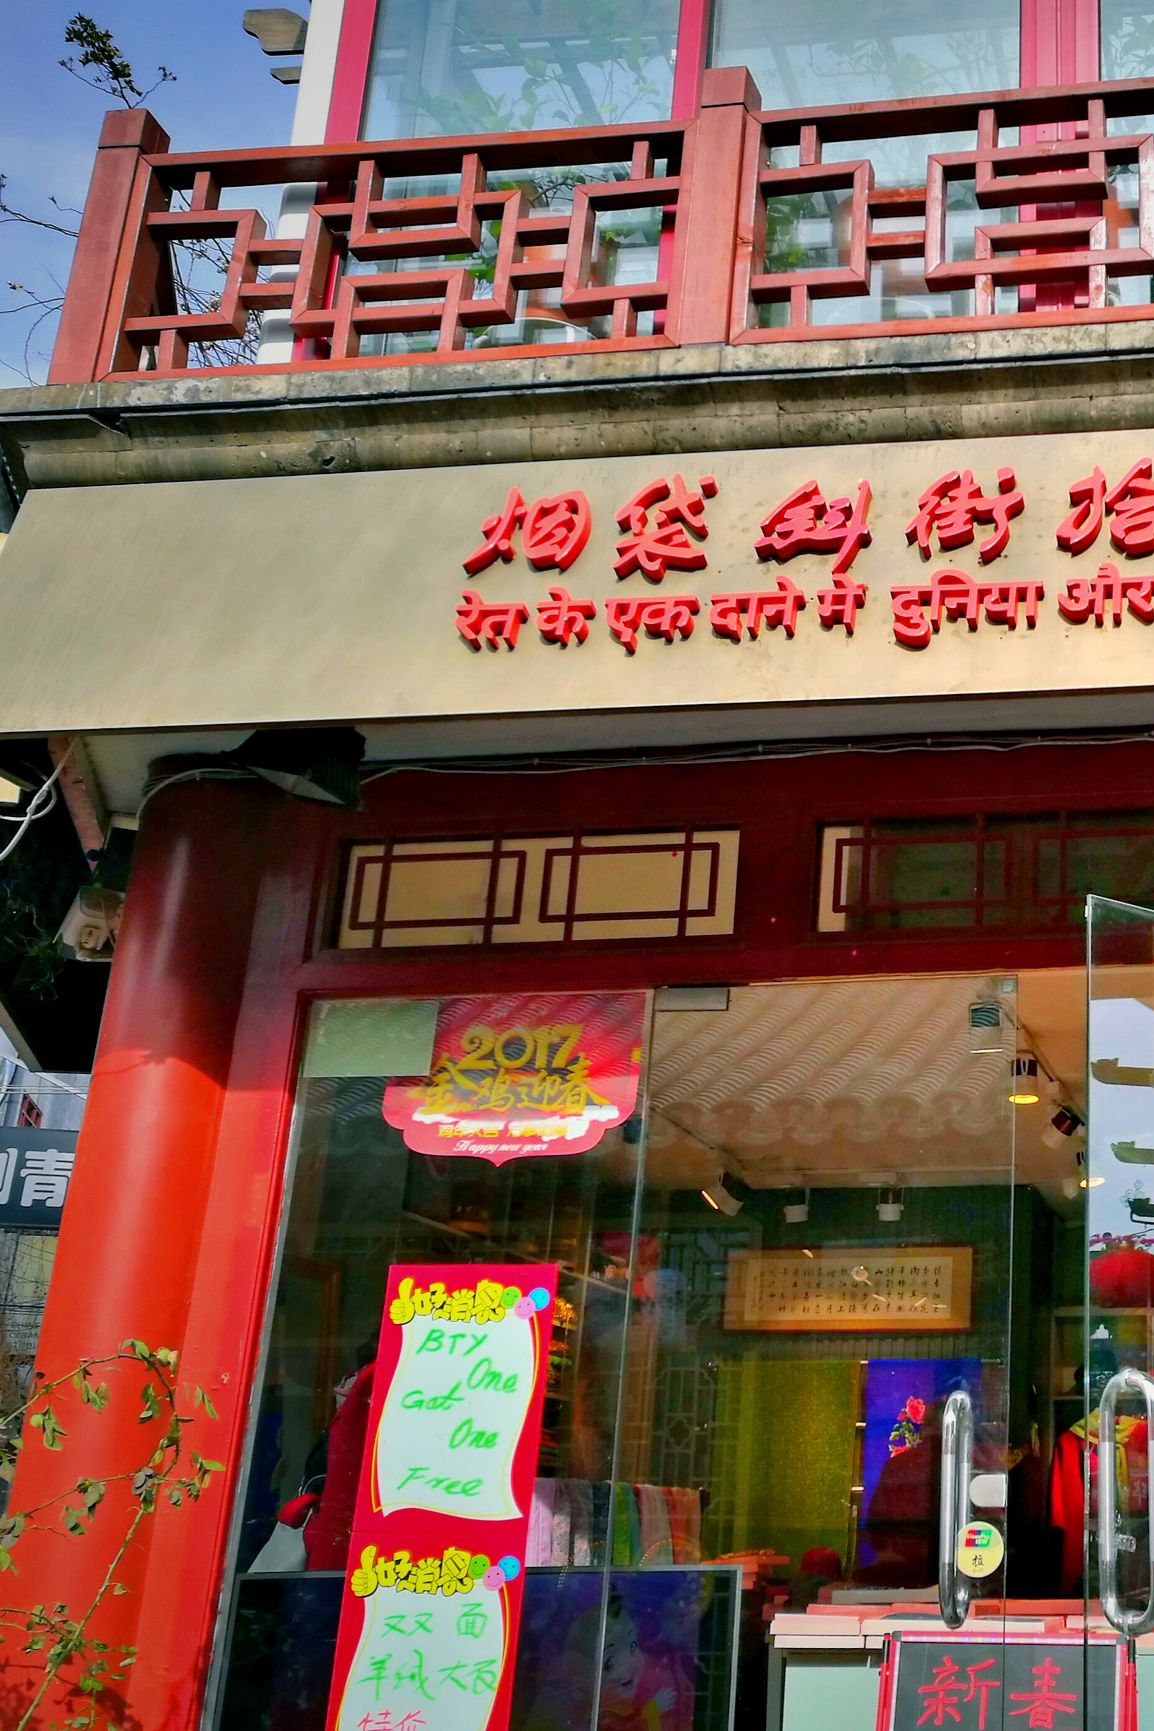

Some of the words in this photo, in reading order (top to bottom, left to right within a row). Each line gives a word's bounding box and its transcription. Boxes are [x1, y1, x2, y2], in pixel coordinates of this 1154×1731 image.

[454, 590, 529, 651] रेत
[536, 587, 597, 647] के
[604, 596, 700, 654] एक
[710, 575, 806, 641] दाने
[891, 570, 1045, 648] दुनिया
[455, 1023, 584, 1070] 2017
[407, 1052, 611, 1115] 金鸡迎春
[452, 1139, 499, 1155] Happy
[411, 1278, 506, 1326] 好消息
[467, 1357, 520, 1394] One
[449, 1417, 499, 1449] One
[397, 1466, 484, 1497] Free
[373, 1547, 475, 1597] 好消息
[916, 1655, 1079, 1730] 新春
